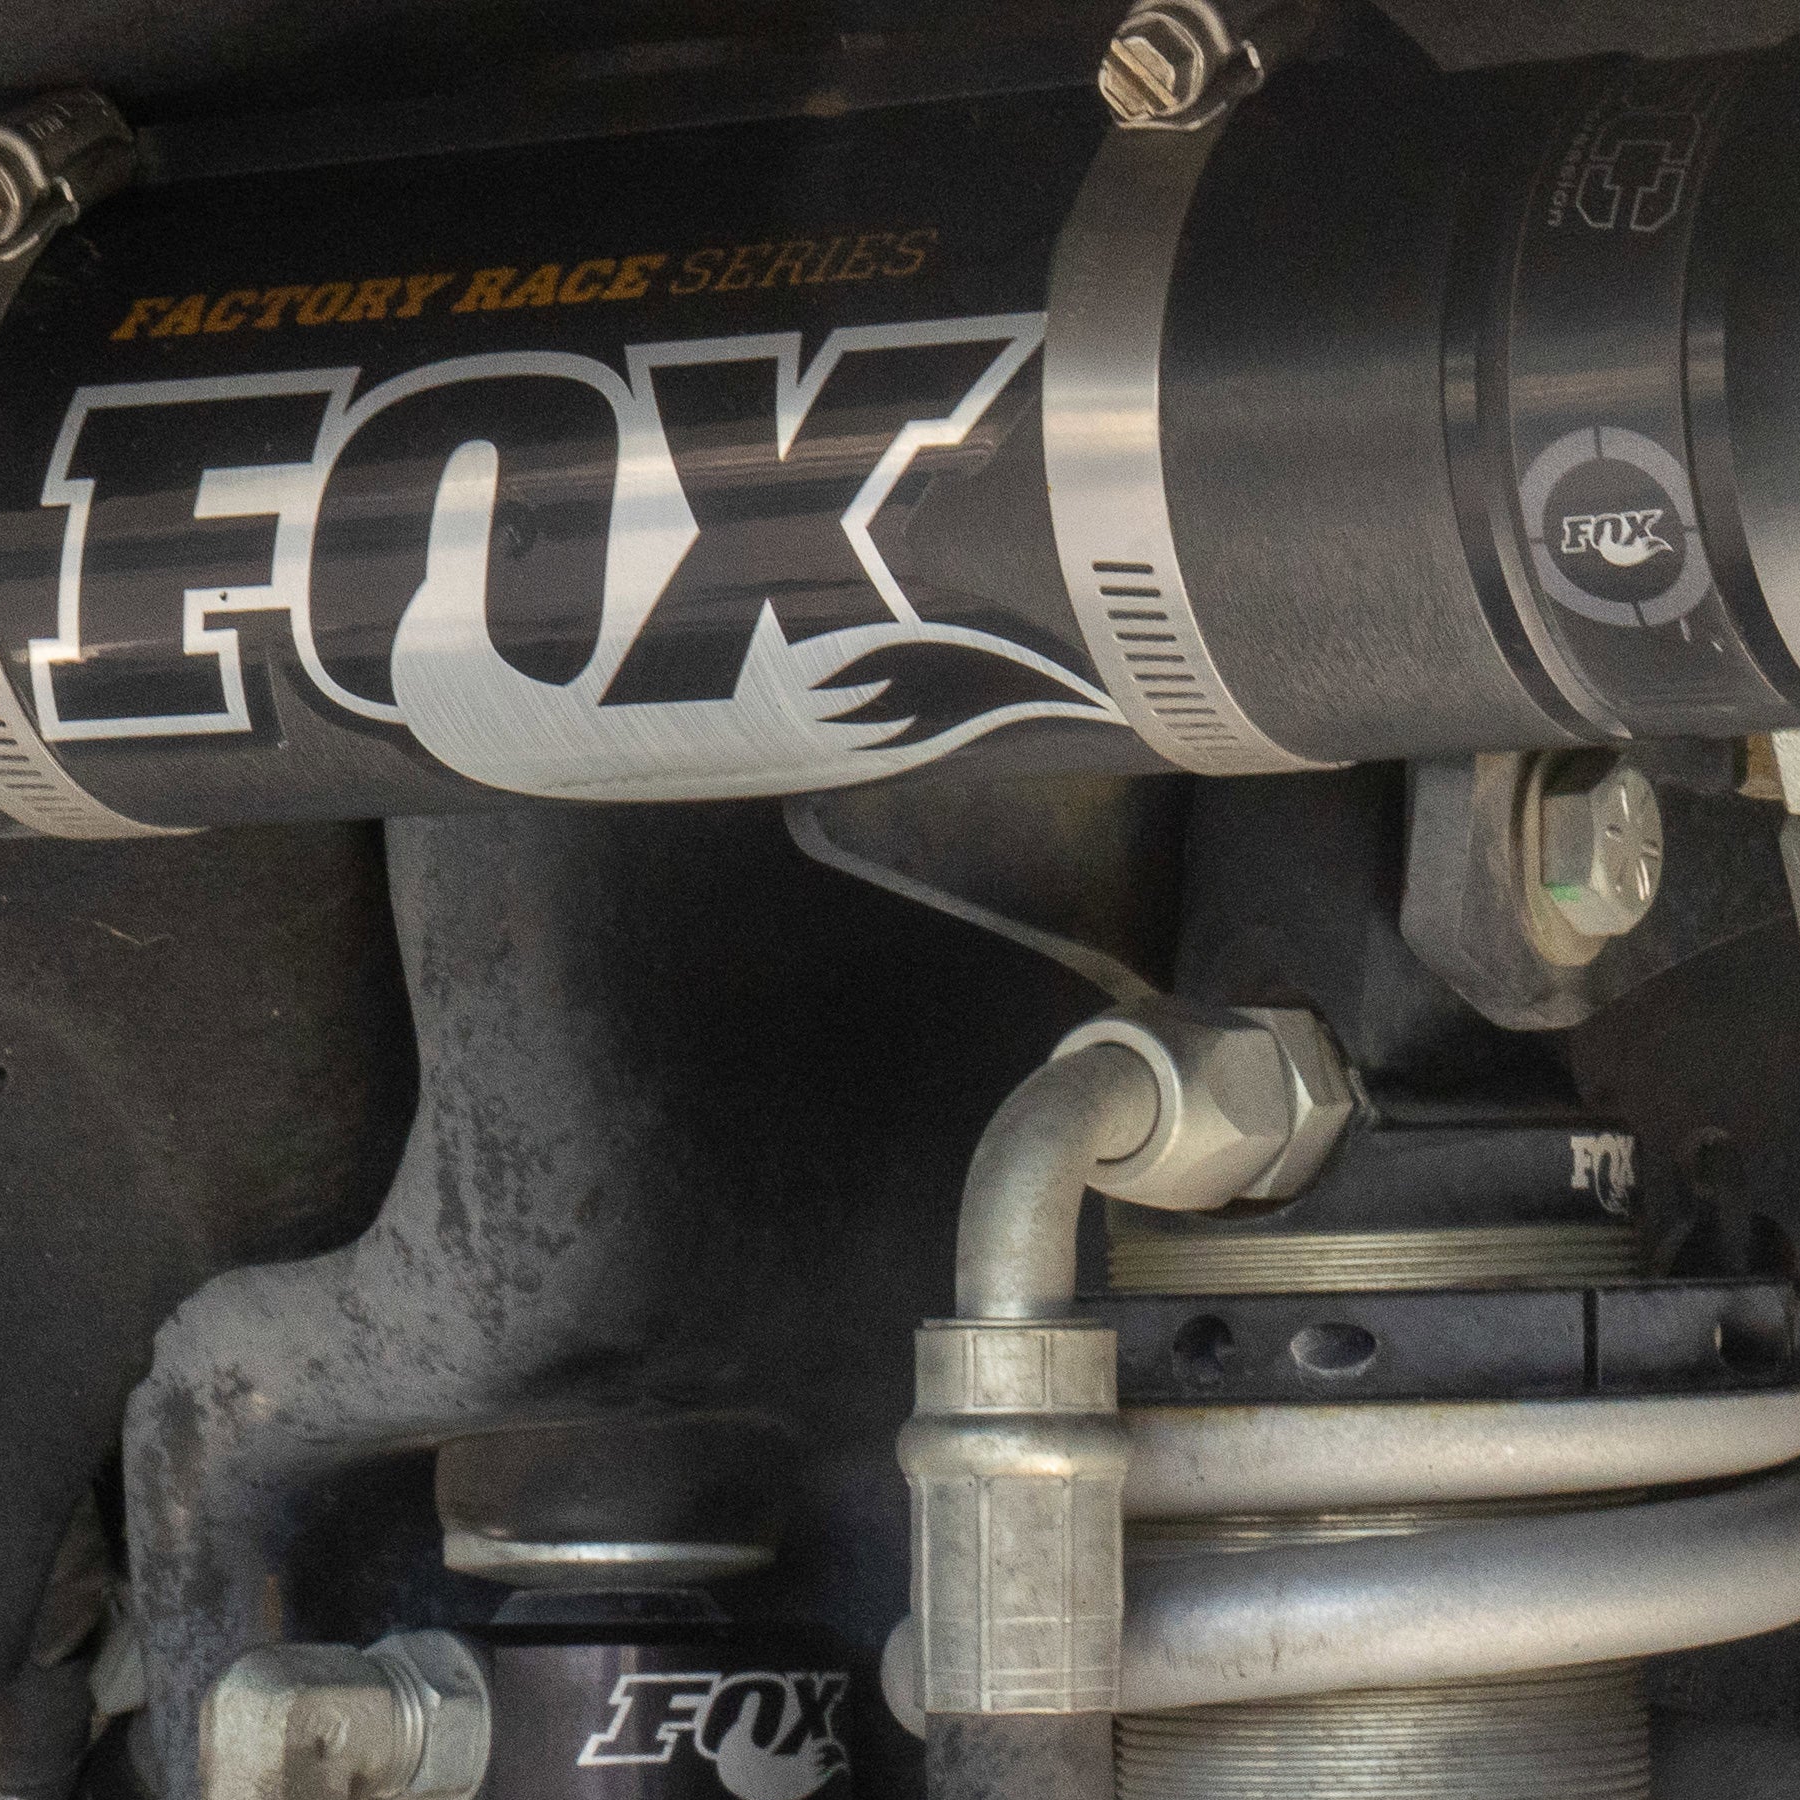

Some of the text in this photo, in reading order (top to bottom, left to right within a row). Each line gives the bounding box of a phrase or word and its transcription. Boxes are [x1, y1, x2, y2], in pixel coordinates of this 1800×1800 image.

[110, 227, 940, 341] FACTORY RACE SERIES
[28, 311, 1124, 801] FOX
[1561, 509, 1674, 568] FOX
[1570, 1132, 1636, 1217] FOX
